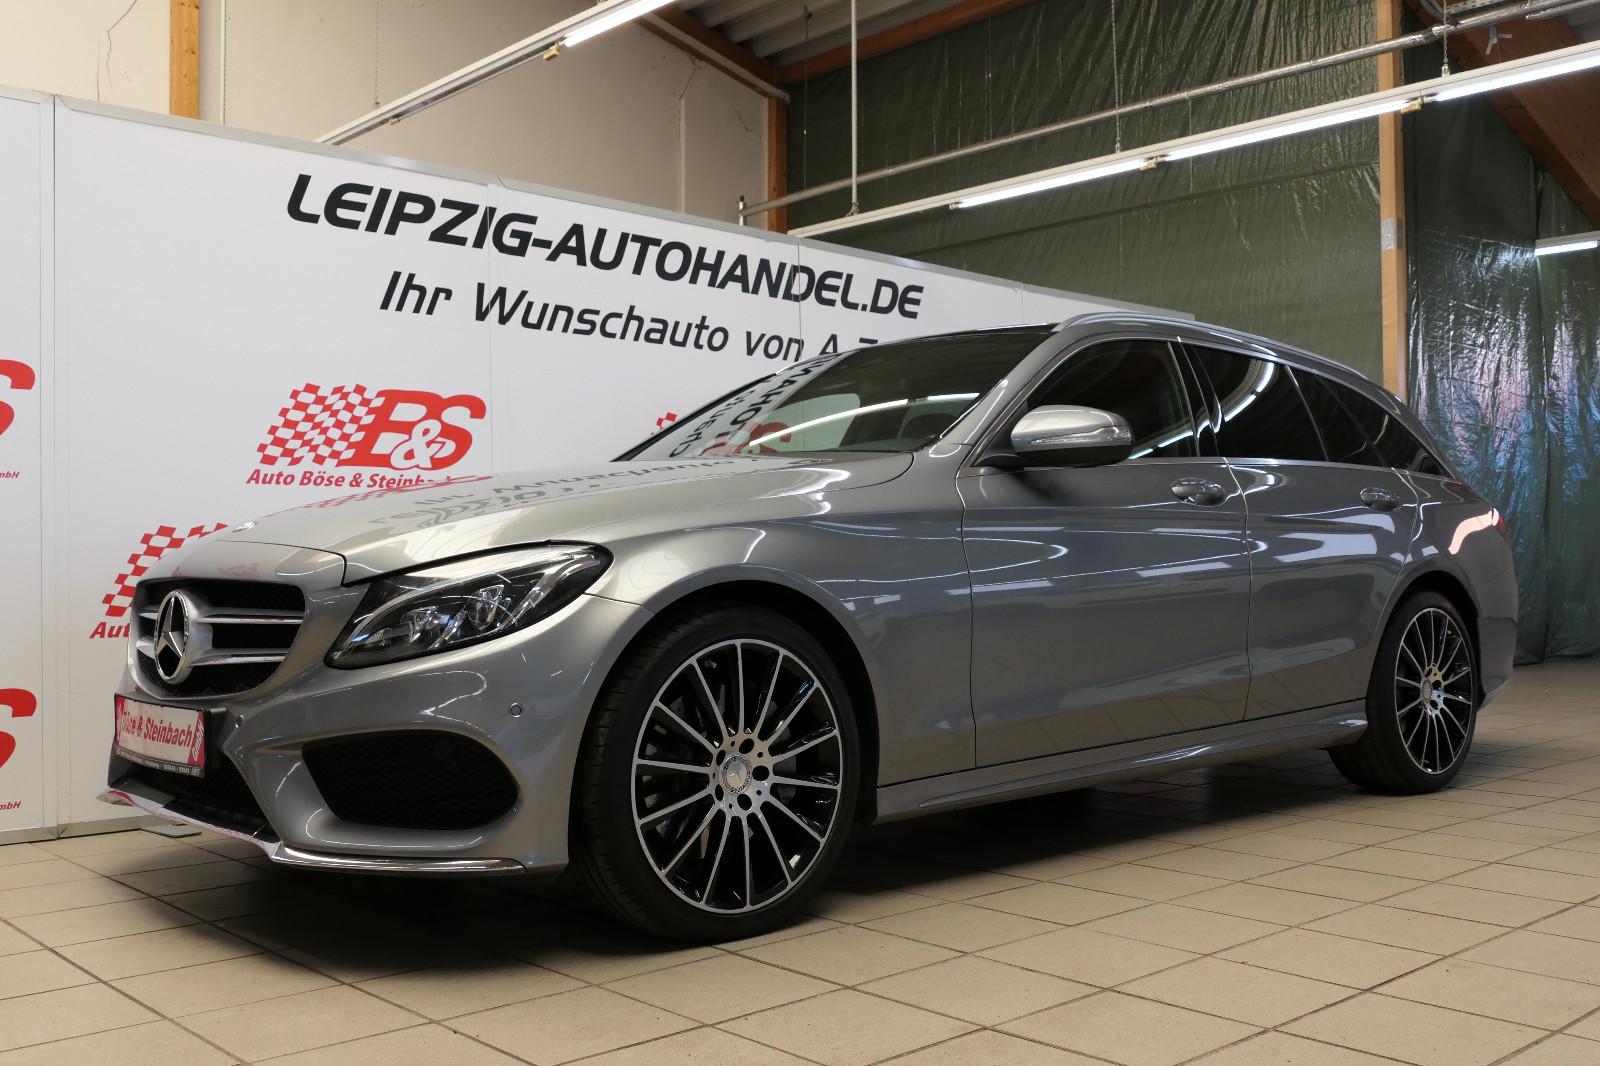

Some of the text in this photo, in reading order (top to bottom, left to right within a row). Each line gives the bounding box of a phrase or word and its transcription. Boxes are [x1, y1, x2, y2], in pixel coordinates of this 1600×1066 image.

[287, 173, 924, 319] LEIPZIG-AUTOHANDEL.DE
[379, 270, 453, 316] Ihr
[475, 282, 729, 353] Wunschauto
[745, 331, 804, 363] von
[246, 469, 295, 486] Auto
[299, 471, 345, 487] Böse
[349, 473, 364, 488] &
[89, 621, 130, 639] Aut
[143, 717, 193, 748] Steinbach
